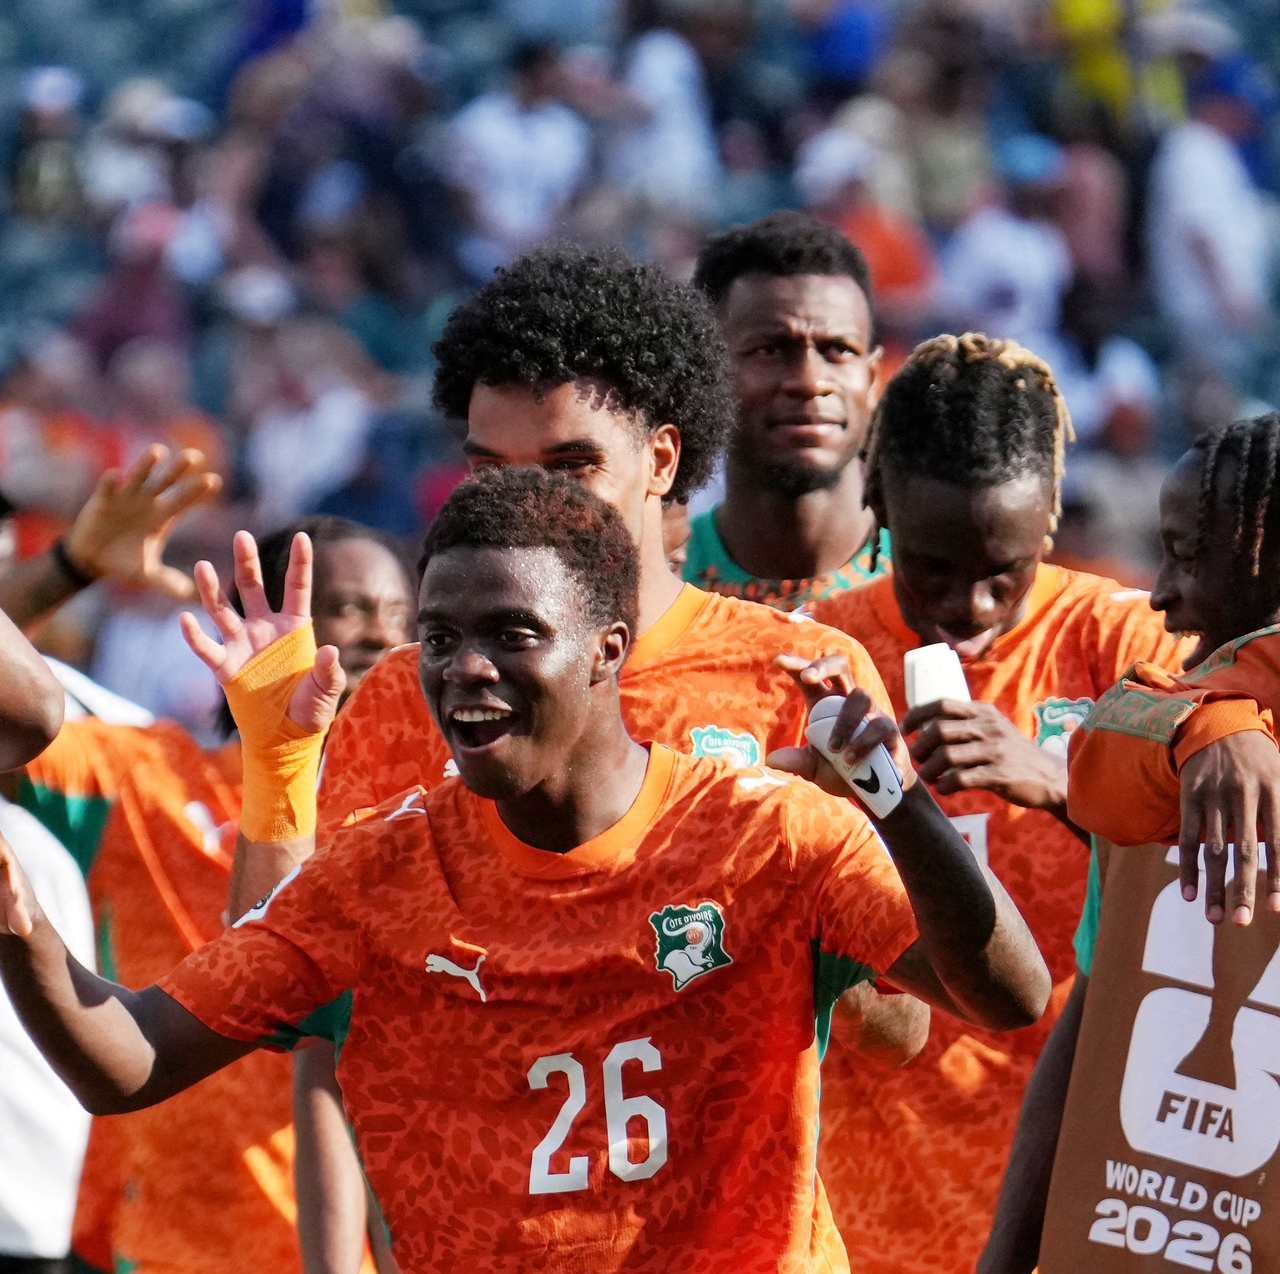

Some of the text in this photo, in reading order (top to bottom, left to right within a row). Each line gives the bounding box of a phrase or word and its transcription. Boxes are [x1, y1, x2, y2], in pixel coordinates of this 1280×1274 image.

[527, 1036, 668, 1195] 26
[1155, 1090, 1236, 1143] FIFA
[1105, 1159, 1262, 1227] WORLD CUP
